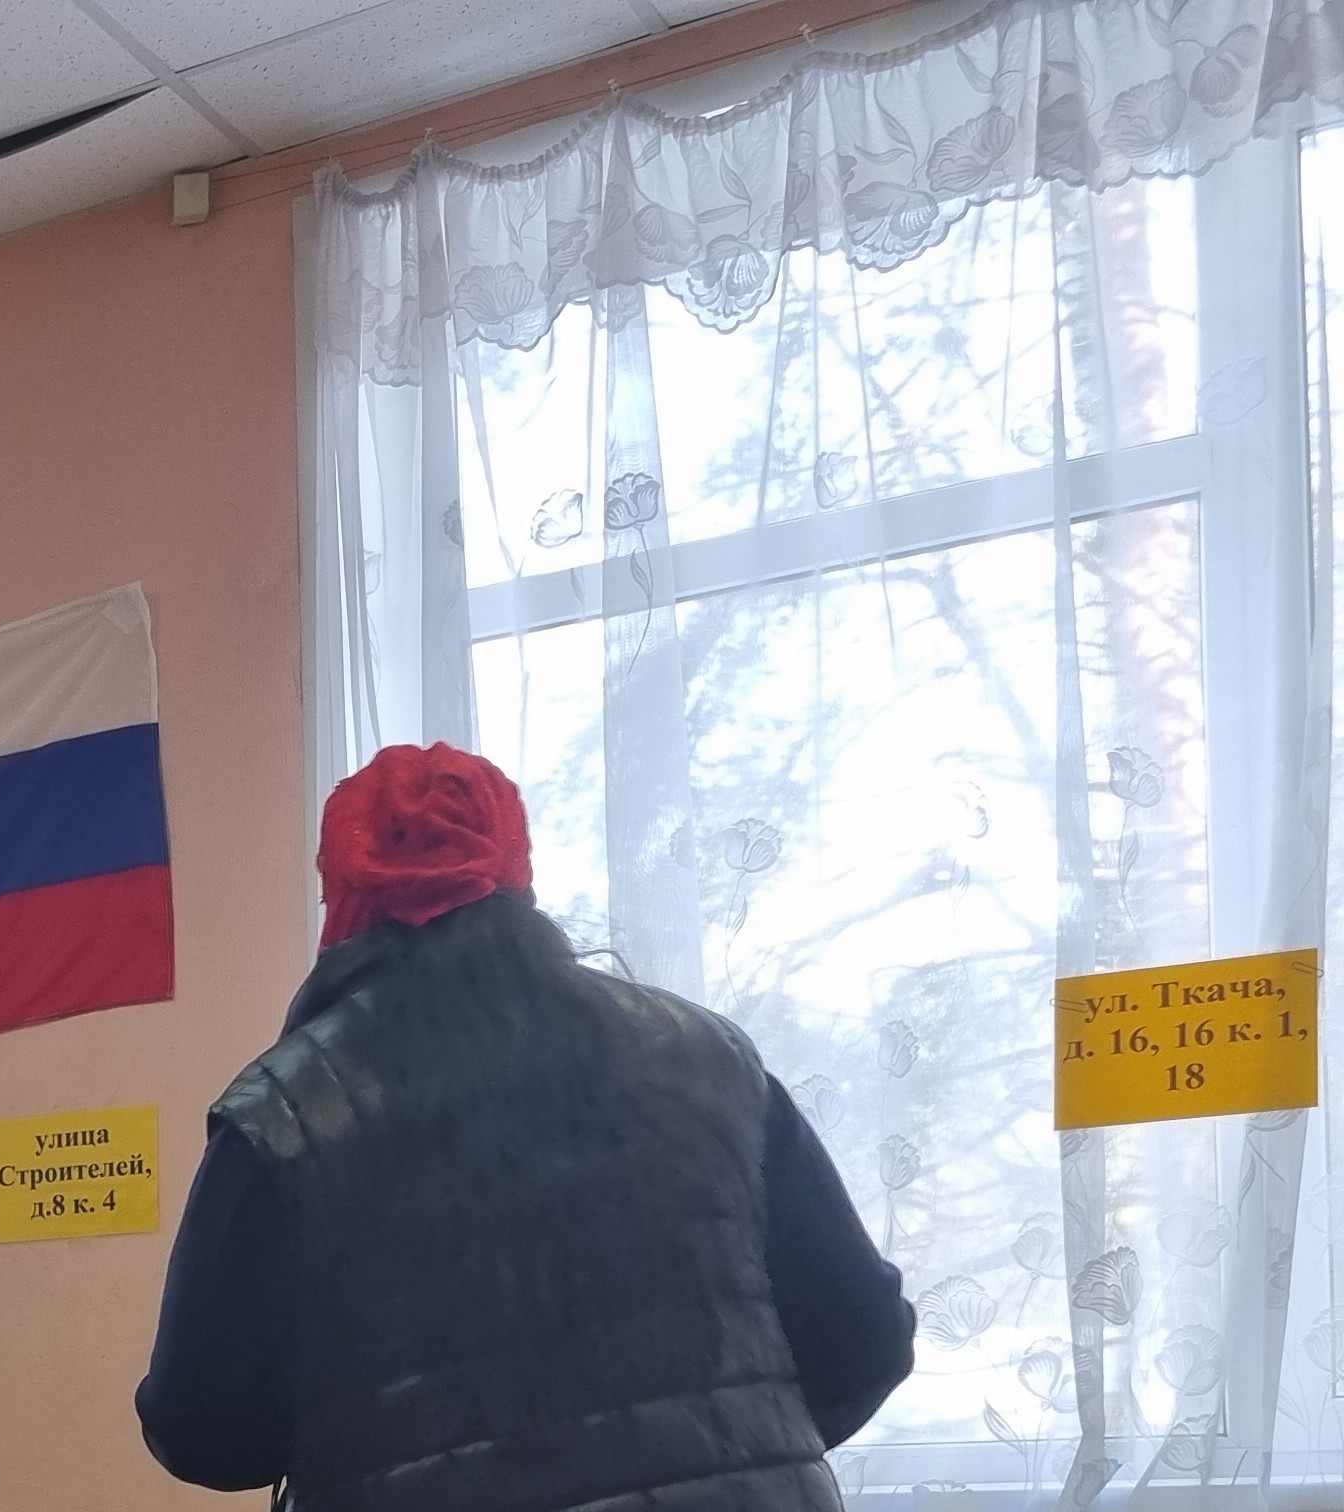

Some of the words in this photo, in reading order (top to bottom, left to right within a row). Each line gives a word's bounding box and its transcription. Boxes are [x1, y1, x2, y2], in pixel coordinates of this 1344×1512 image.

[1083, 993, 1140, 1024] ул.
[1151, 976, 1287, 1010] Ткача,
[1062, 1040, 1095, 1065] д.
[1109, 1025, 1161, 1058] 16,
[1173, 1018, 1215, 1050] 16
[1226, 1021, 1263, 1044] к.
[1276, 1009, 1310, 1041] 1,
[1164, 1062, 1206, 1092] 18
[35, 1127, 110, 1157] улица
[30, 1193, 66, 1221] д.8
[72, 1197, 96, 1215] к.
[102, 1188, 117, 1212] 4
